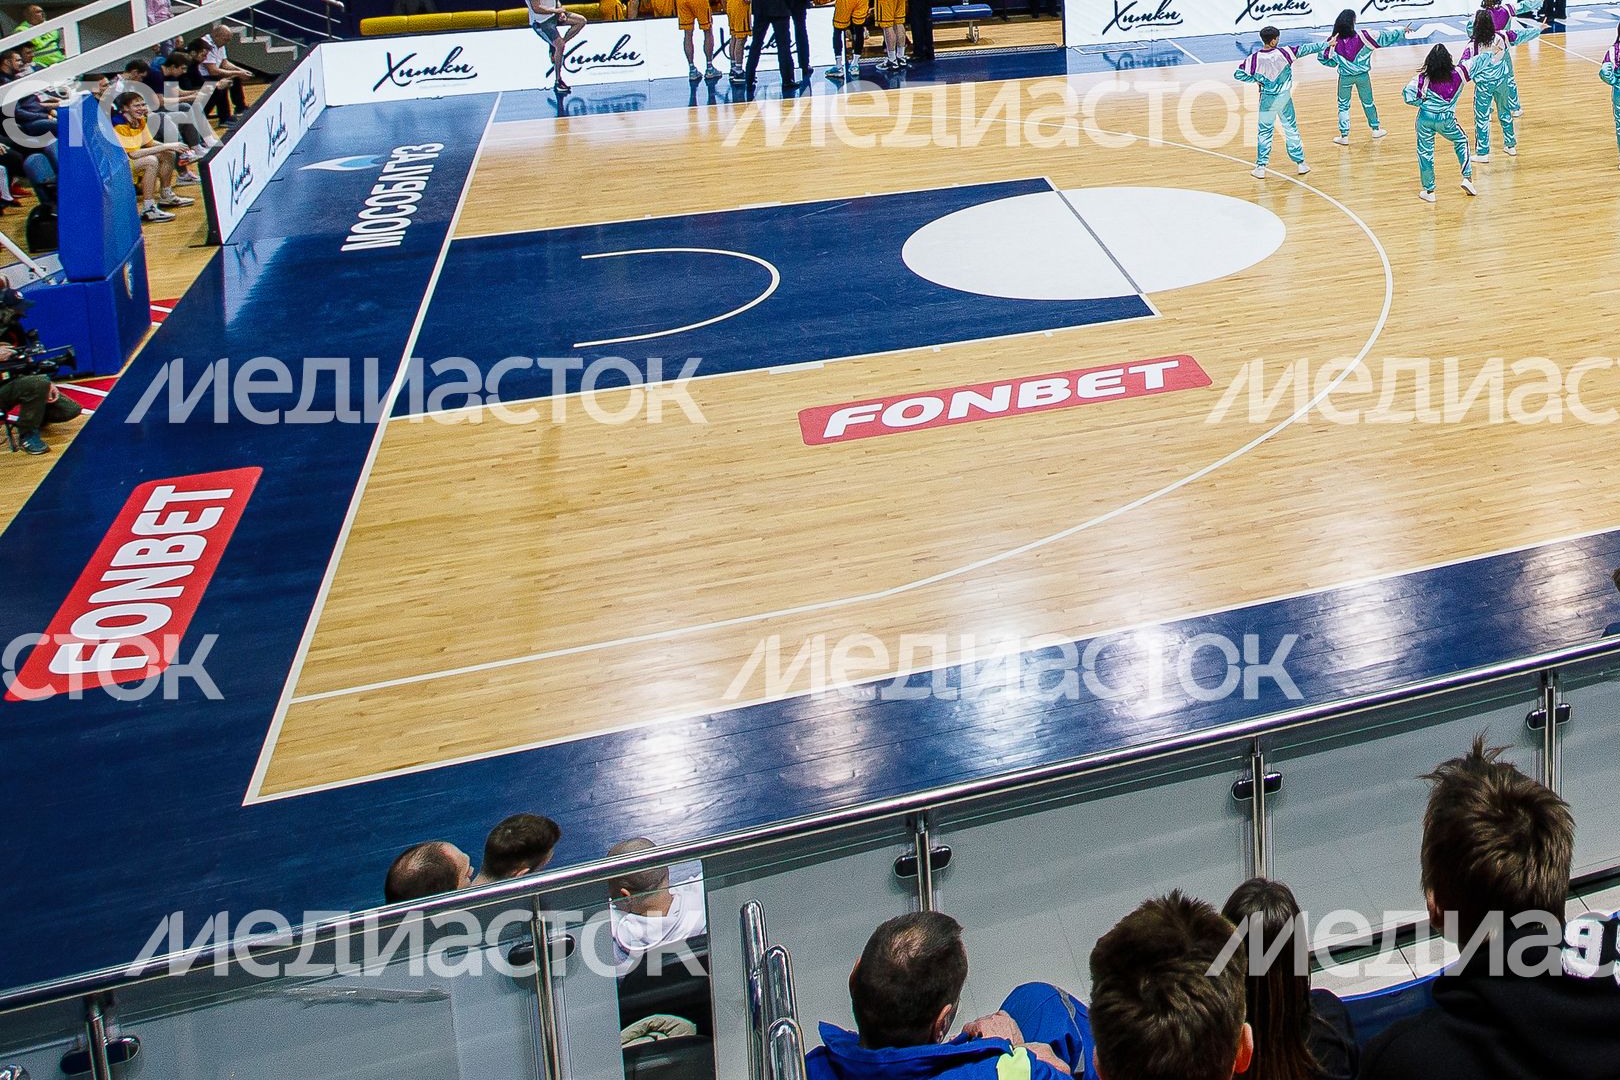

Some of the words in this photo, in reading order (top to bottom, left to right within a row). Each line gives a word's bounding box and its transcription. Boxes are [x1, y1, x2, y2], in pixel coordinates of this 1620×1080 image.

[372, 46, 478, 92] Химки
[340, 142, 444, 252] МОСОБЛГАЗ
[823, 360, 1179, 438] FONBET
[48, 485, 234, 675] FONBET
